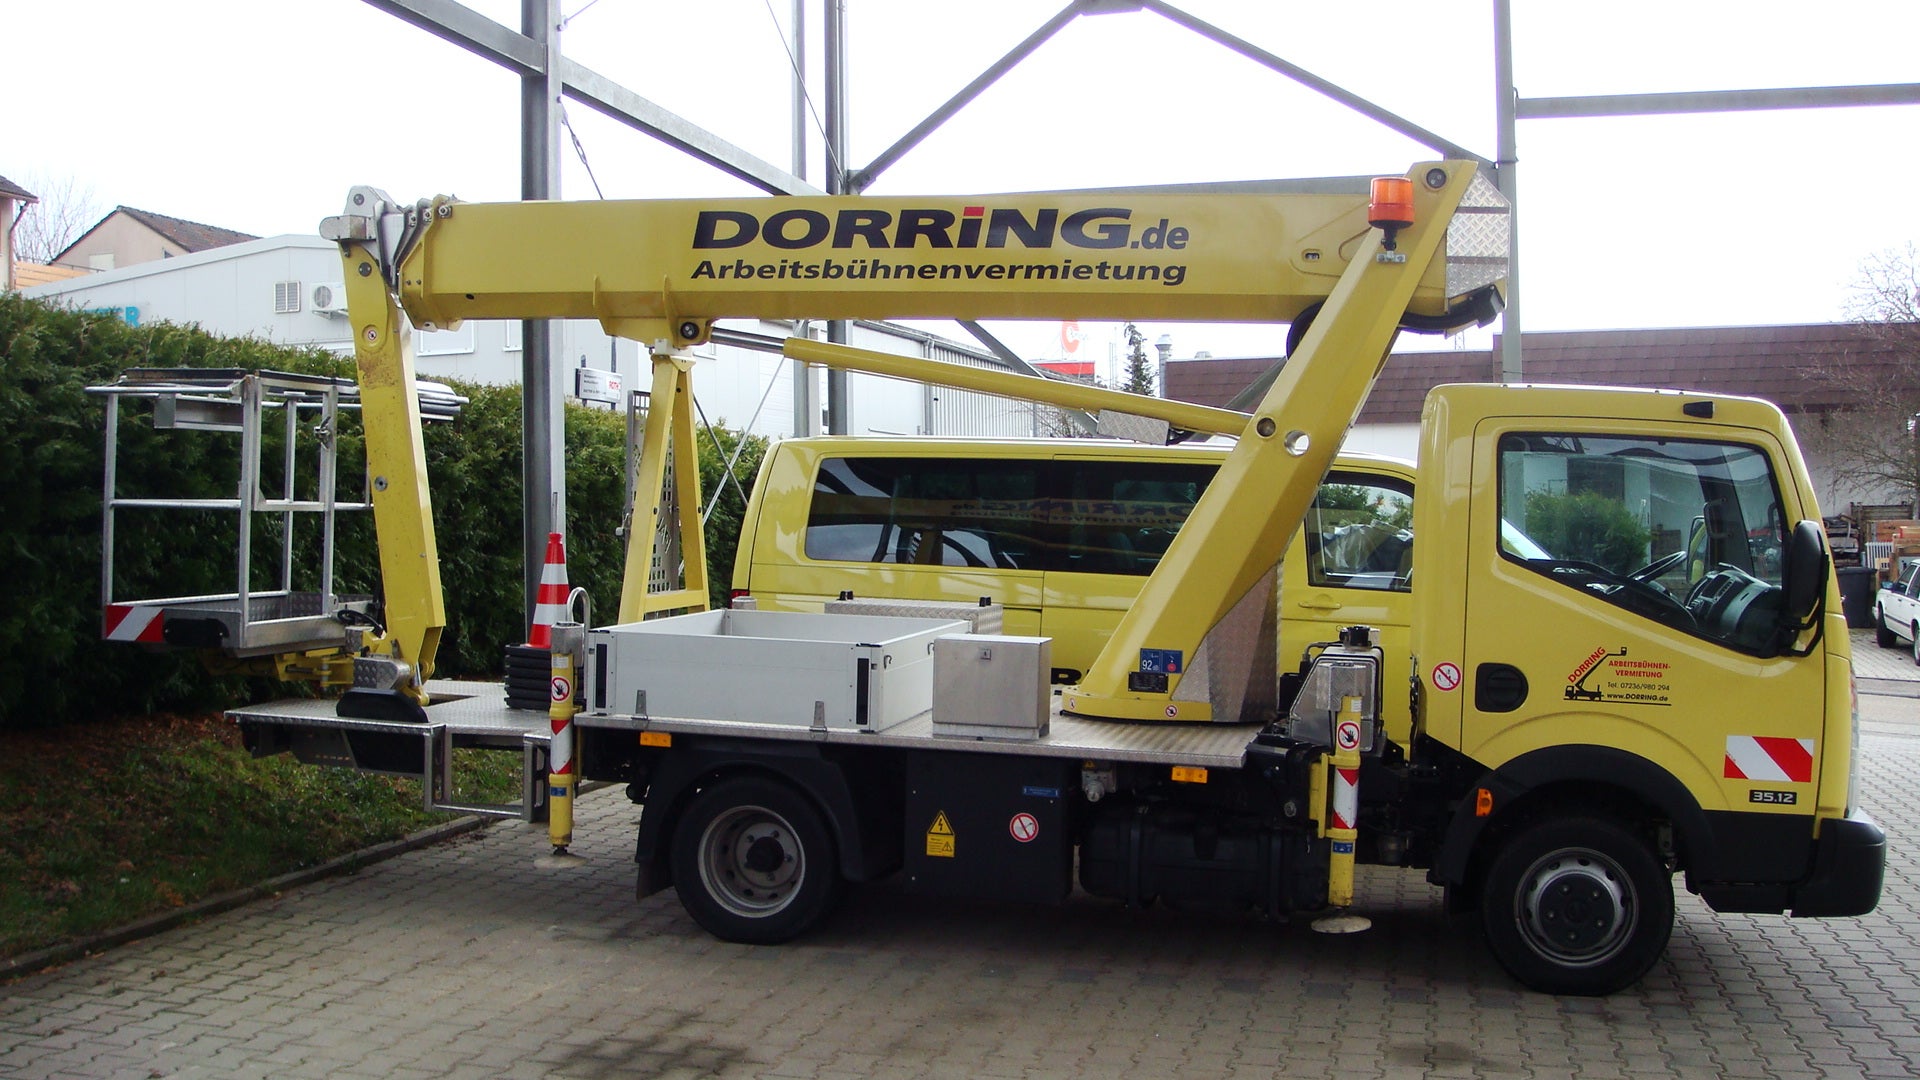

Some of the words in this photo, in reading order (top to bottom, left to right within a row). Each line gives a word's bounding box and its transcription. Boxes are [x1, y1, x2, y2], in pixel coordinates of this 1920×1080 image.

[691, 258, 1187, 286] Arbeitsbühnenvermietung
[1142, 660, 1153, 671] 92
[1567, 646, 1606, 683] DORRING
[1608, 660, 1671, 670] ARBEITSBÜHNEN-
[1615, 669, 1663, 678] VERMIETUNG
[1607, 693, 1668, 701] www.DORRING.de
[1753, 791, 1794, 803] 35.12
